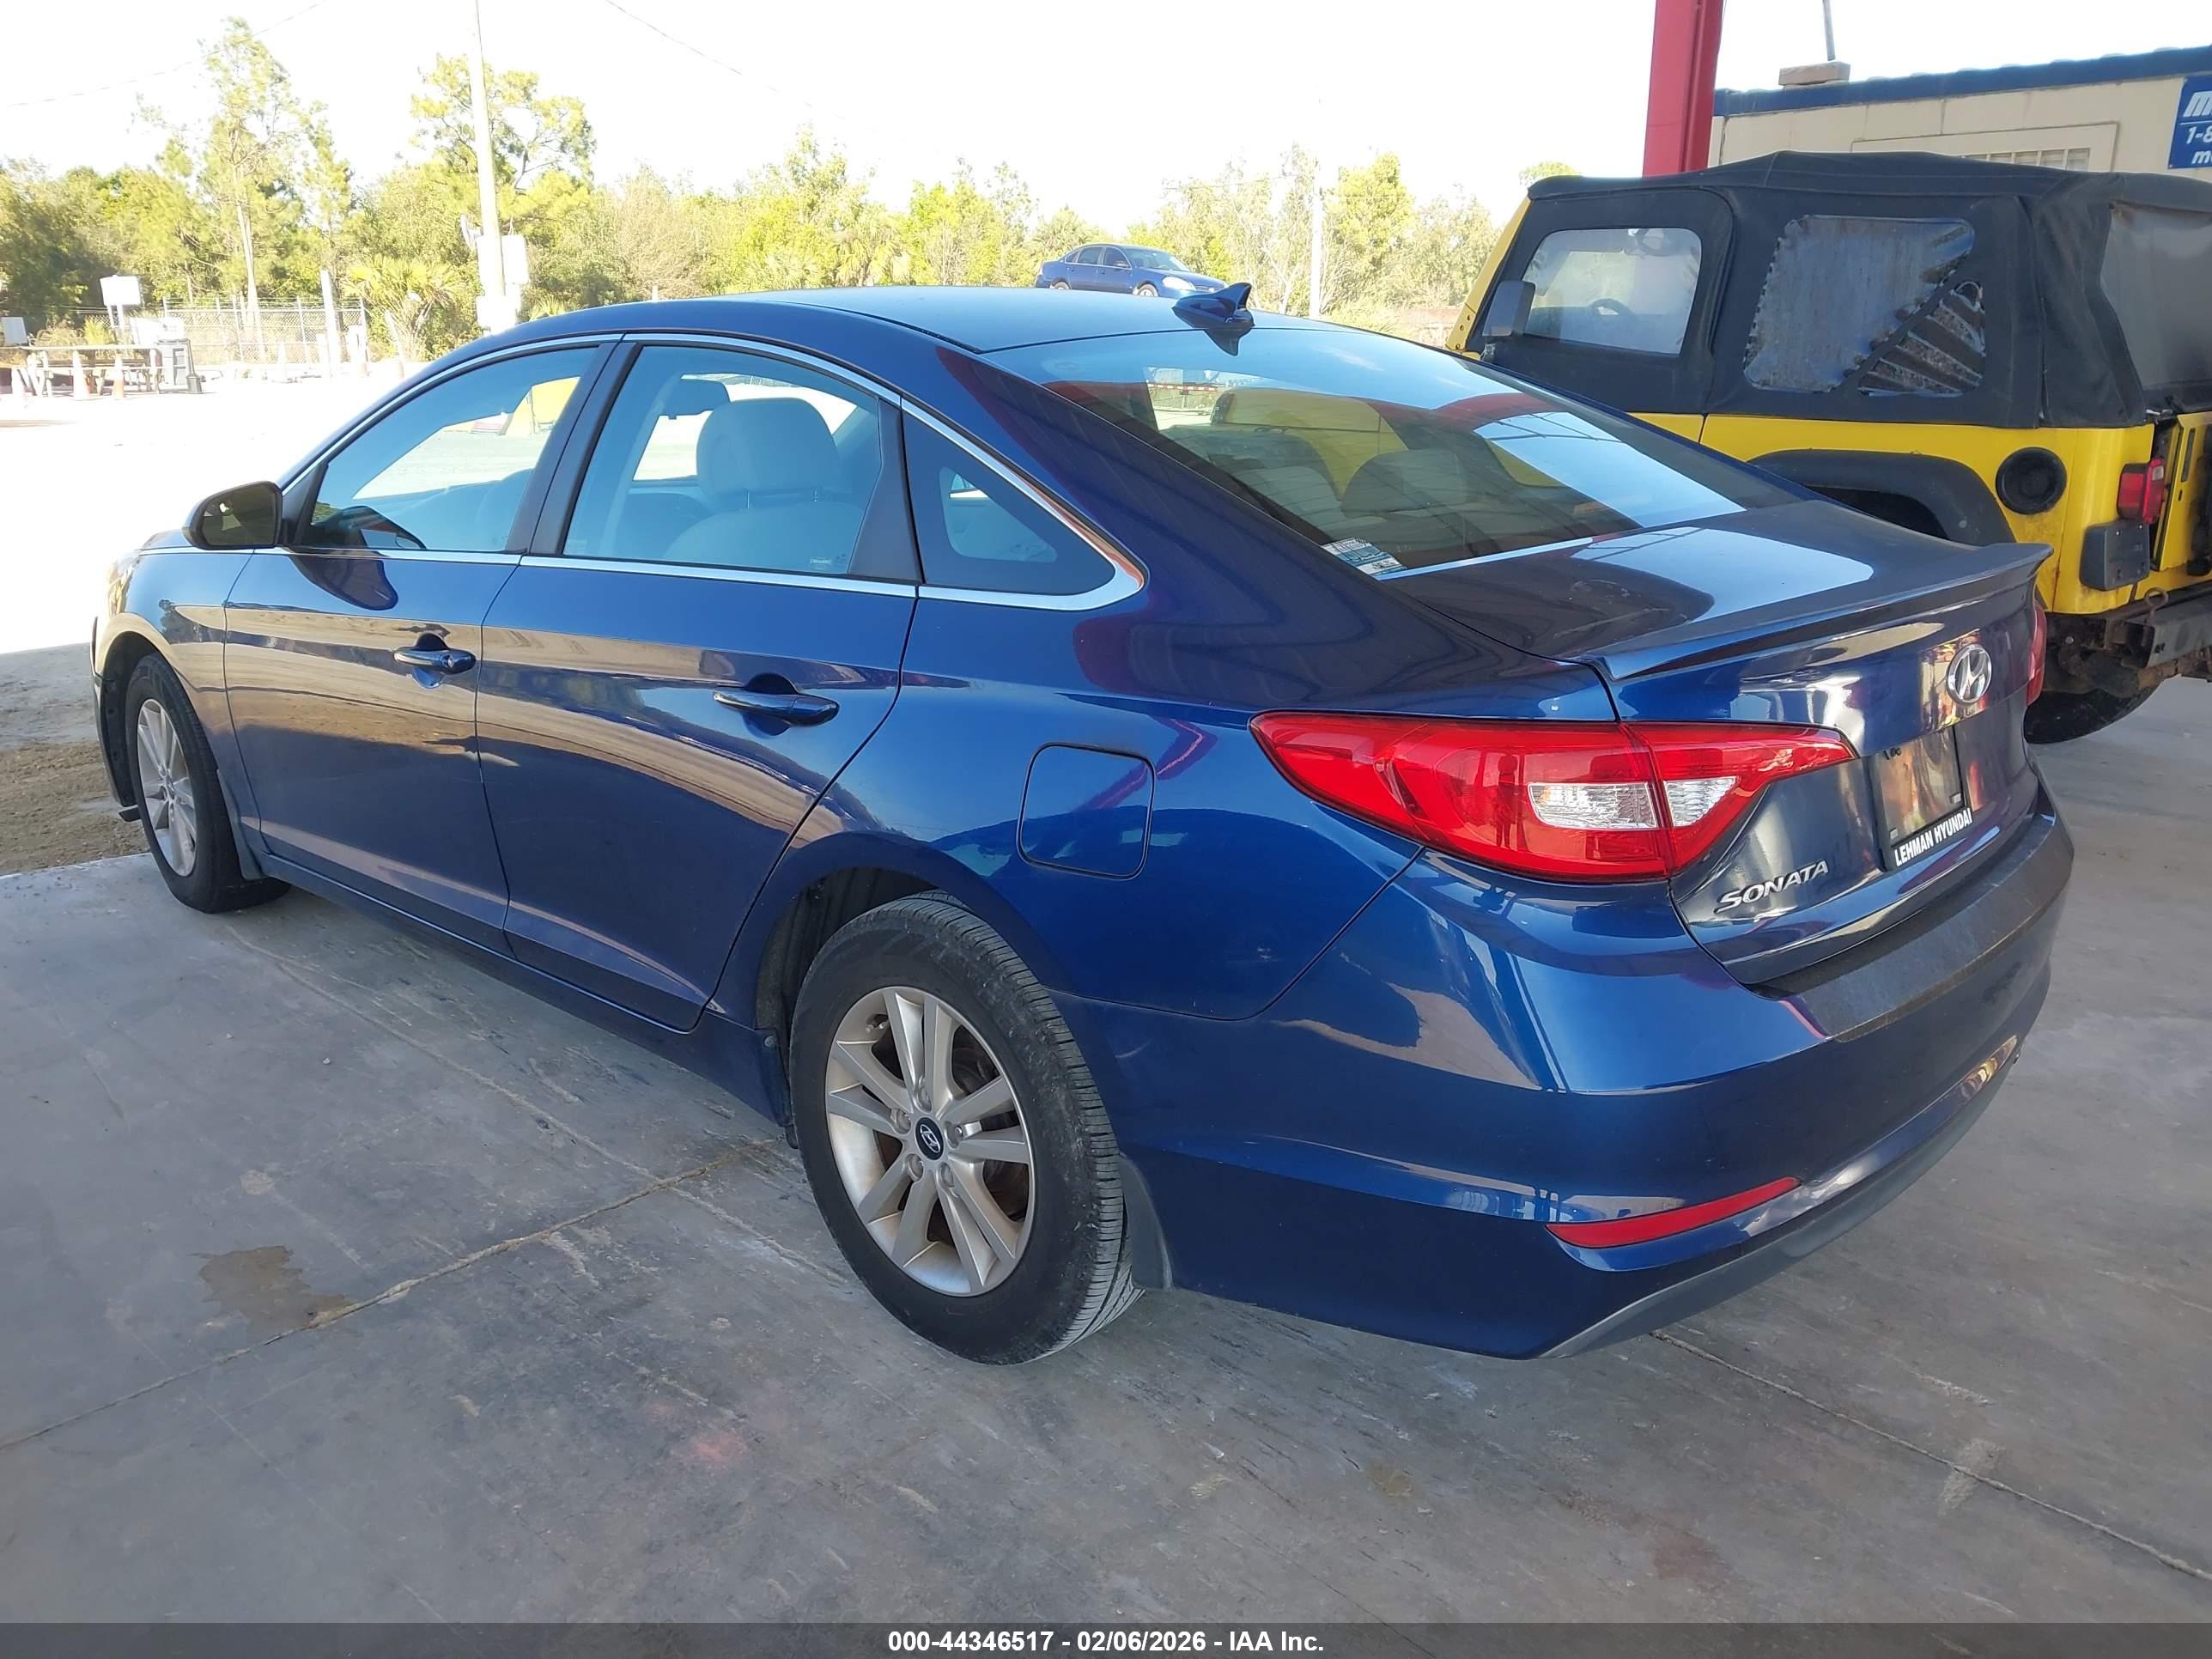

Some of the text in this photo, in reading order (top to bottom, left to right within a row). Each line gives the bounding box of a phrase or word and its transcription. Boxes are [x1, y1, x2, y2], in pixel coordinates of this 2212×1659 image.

[1894, 807, 1973, 866] LEHMAN HYUNDAI
[1713, 860, 1829, 914] SONATA
